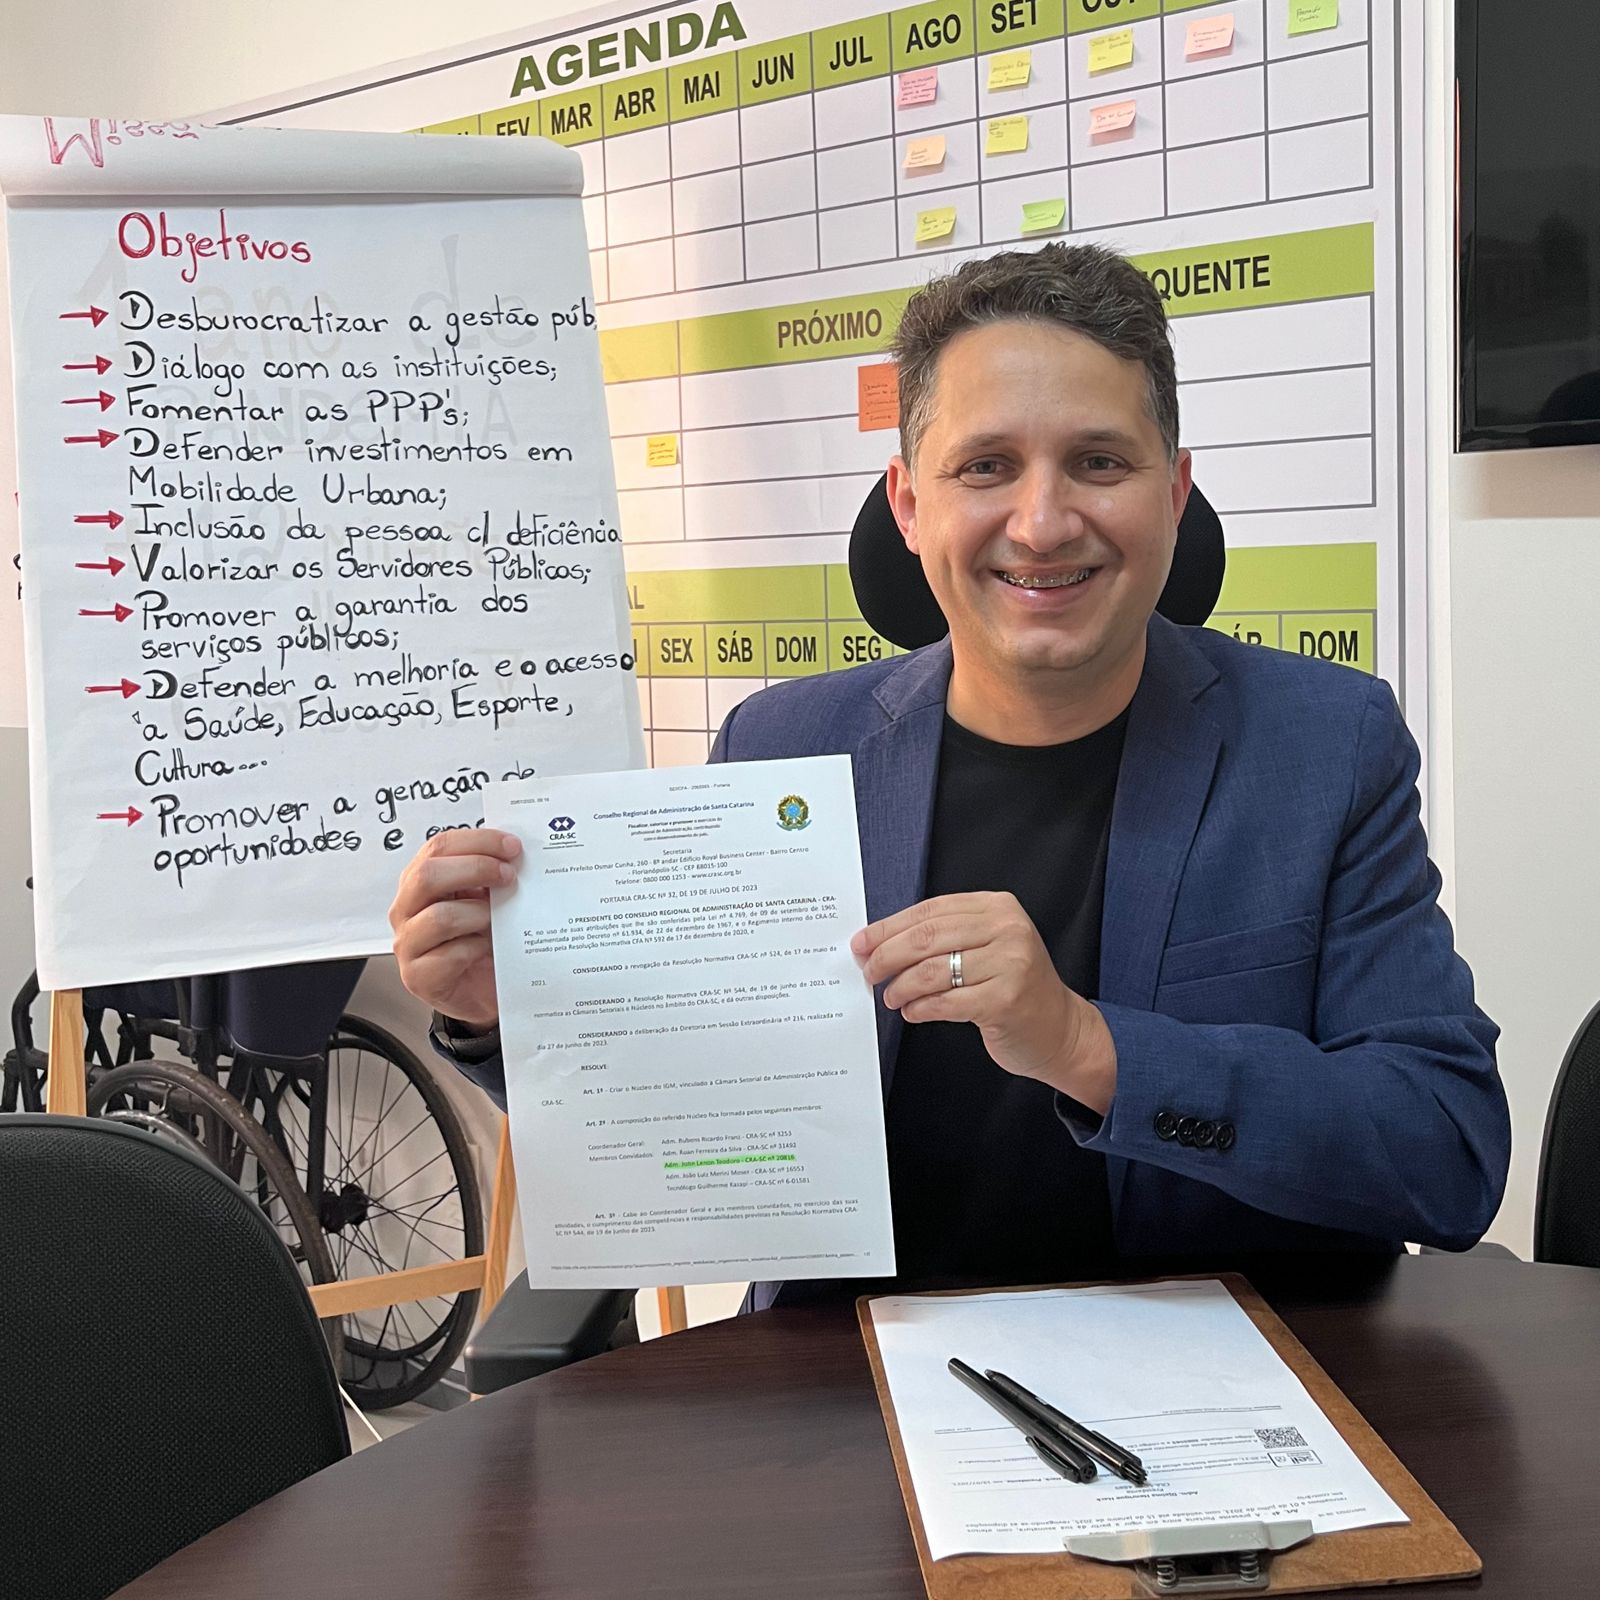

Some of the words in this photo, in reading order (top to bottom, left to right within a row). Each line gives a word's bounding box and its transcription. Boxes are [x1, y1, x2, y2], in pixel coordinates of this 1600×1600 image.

[906, 14, 961, 54] AGO
[991, 0, 1037, 33] SET
[510, 1, 747, 98] AGENDA
[829, 36, 873, 71] JUL
[683, 71, 721, 105] MAI
[752, 53, 795, 88] JUN
[551, 103, 593, 135] MAR
[614, 88, 656, 121] ABR
[118, 208, 311, 283] Objetivos
[1144, 255, 1271, 301] QUENTE
[119, 290, 389, 335] Desburocratizar
[409, 315, 431, 332] a
[445, 294, 539, 347] gestão
[777, 307, 883, 350] PRÓXIMO
[124, 340, 245, 397] Diálogo
[263, 361, 329, 379] com
[342, 361, 377, 379] as
[393, 347, 557, 386] instituições;
[126, 383, 284, 421] Fomentar
[305, 404, 349, 422] as
[366, 388, 469, 427] PPP's;
[124, 427, 283, 461] Defender
[305, 426, 507, 463] investimentos
[528, 446, 573, 462] em
[129, 465, 298, 503] Mobilidade
[323, 472, 447, 510] Urbana;
[130, 503, 265, 541] Inclusão
[286, 507, 326, 540] da
[345, 524, 452, 555] pessoa
[506, 509, 622, 547] deficiência
[130, 543, 279, 583] Valorizar
[292, 561, 324, 579] os
[336, 548, 473, 580] Servidores
[483, 546, 592, 584] Públicos;
[134, 590, 277, 631] Promover
[295, 605, 317, 623] a
[333, 584, 457, 637] garantia
[481, 583, 528, 613] dos
[141, 635, 262, 664] serviços
[277, 622, 399, 671] públicos;
[661, 637, 694, 663] SEX
[717, 630, 753, 663] SÁB
[776, 636, 817, 663] DOM
[843, 635, 881, 662] SEG
[1300, 630, 1358, 662] DOM
[142, 665, 296, 699] Defender
[315, 674, 337, 691] a
[354, 652, 479, 686] melhoria
[546, 652, 634, 674] acesso
[184, 702, 284, 741] Saúde,
[299, 692, 442, 728] Educação,
[452, 682, 573, 731] Esporte,
[150, 793, 309, 838] Promover
[333, 797, 357, 815] a
[592, 811, 621, 819] Conselho
[622, 809, 648, 818] Regional
[657, 805, 701, 814] Administração
[154, 815, 361, 889] oportunidades
[383, 828, 405, 851] e
[548, 832, 576, 840] CRA-SC
[574, 914, 611, 923] PRESIDENTE
[623, 910, 658, 919] CONSELHO
[658, 907, 690, 916] REGIONAL
[701, 902, 754, 912] ADMINISTRAÇÃO
[599, 895, 631, 903] PORTARIA
[632, 893, 656, 901] CRA-SC
[709, 886, 730, 894] JULHO
